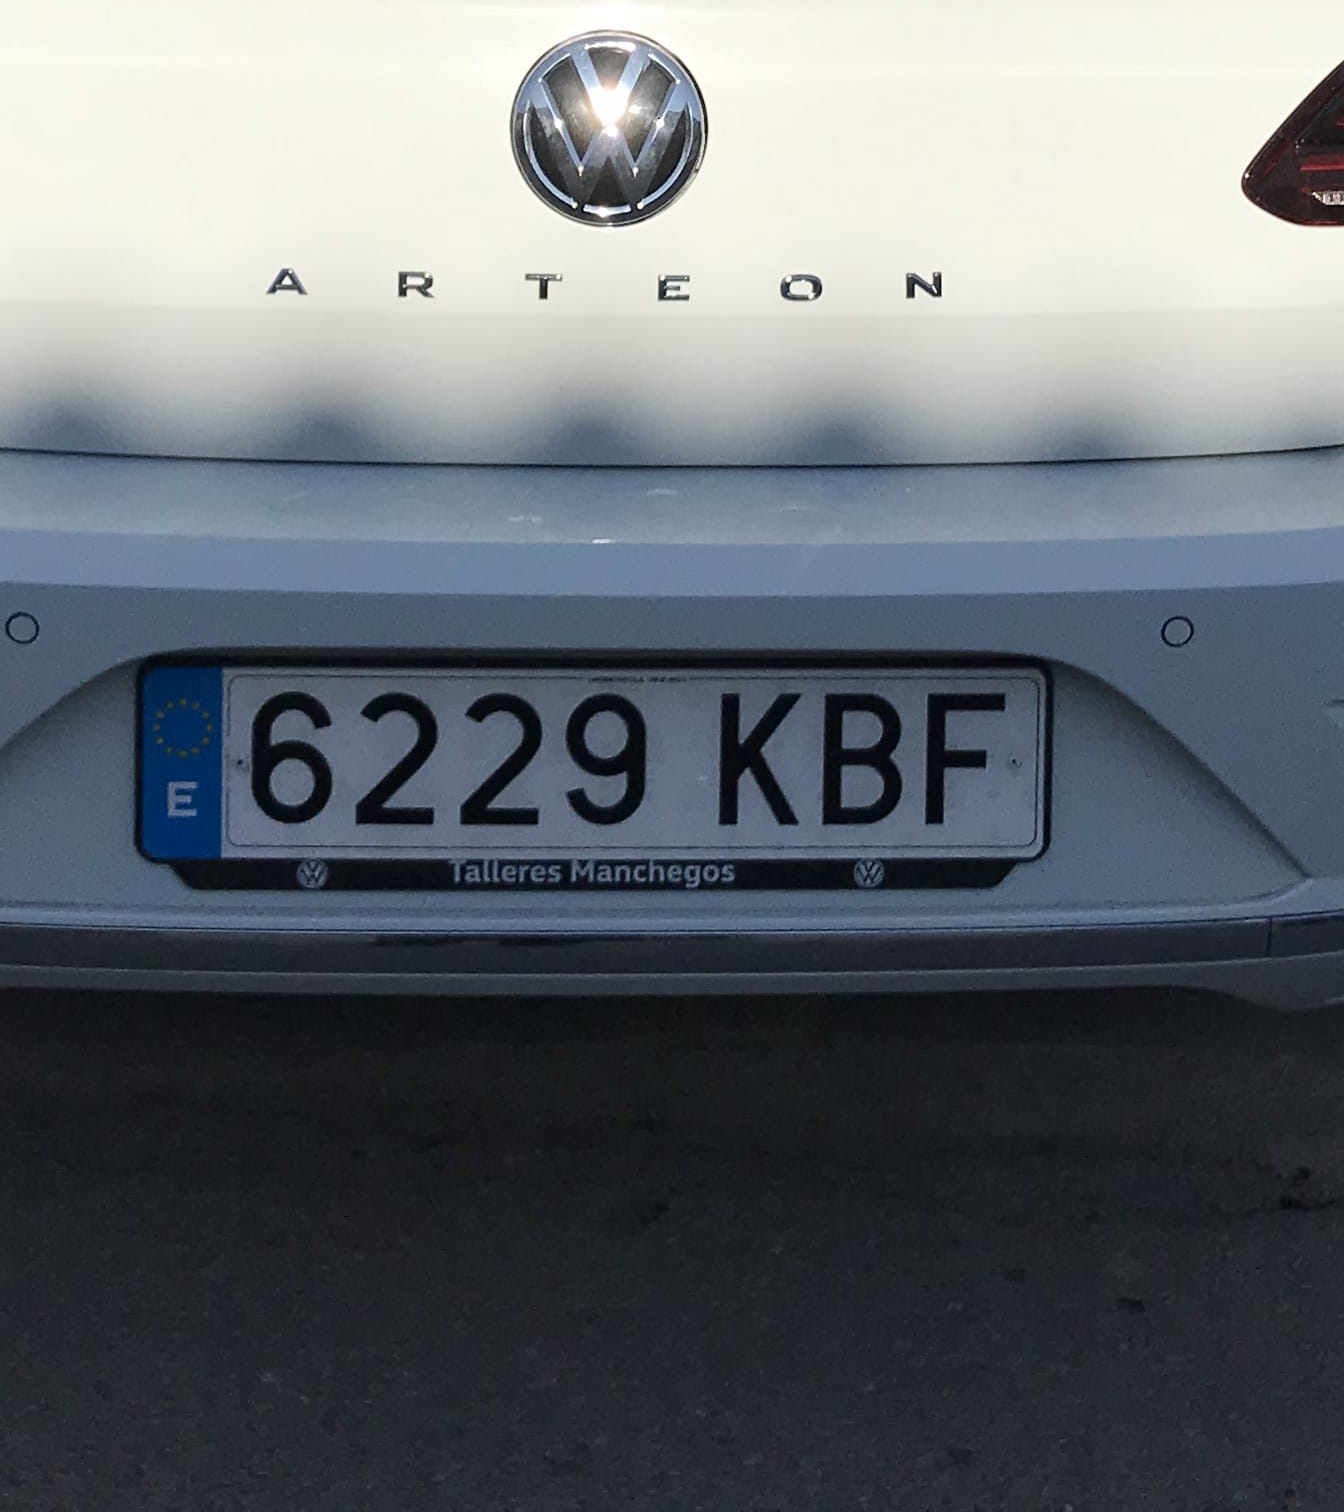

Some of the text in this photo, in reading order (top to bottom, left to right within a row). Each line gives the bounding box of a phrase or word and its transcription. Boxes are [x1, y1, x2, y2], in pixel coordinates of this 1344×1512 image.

[265, 267, 943, 302] ARTEON
[251, 691, 1006, 825] 6229 KBF
[167, 781, 197, 817] E
[450, 858, 736, 888] Talleres Manchegos
